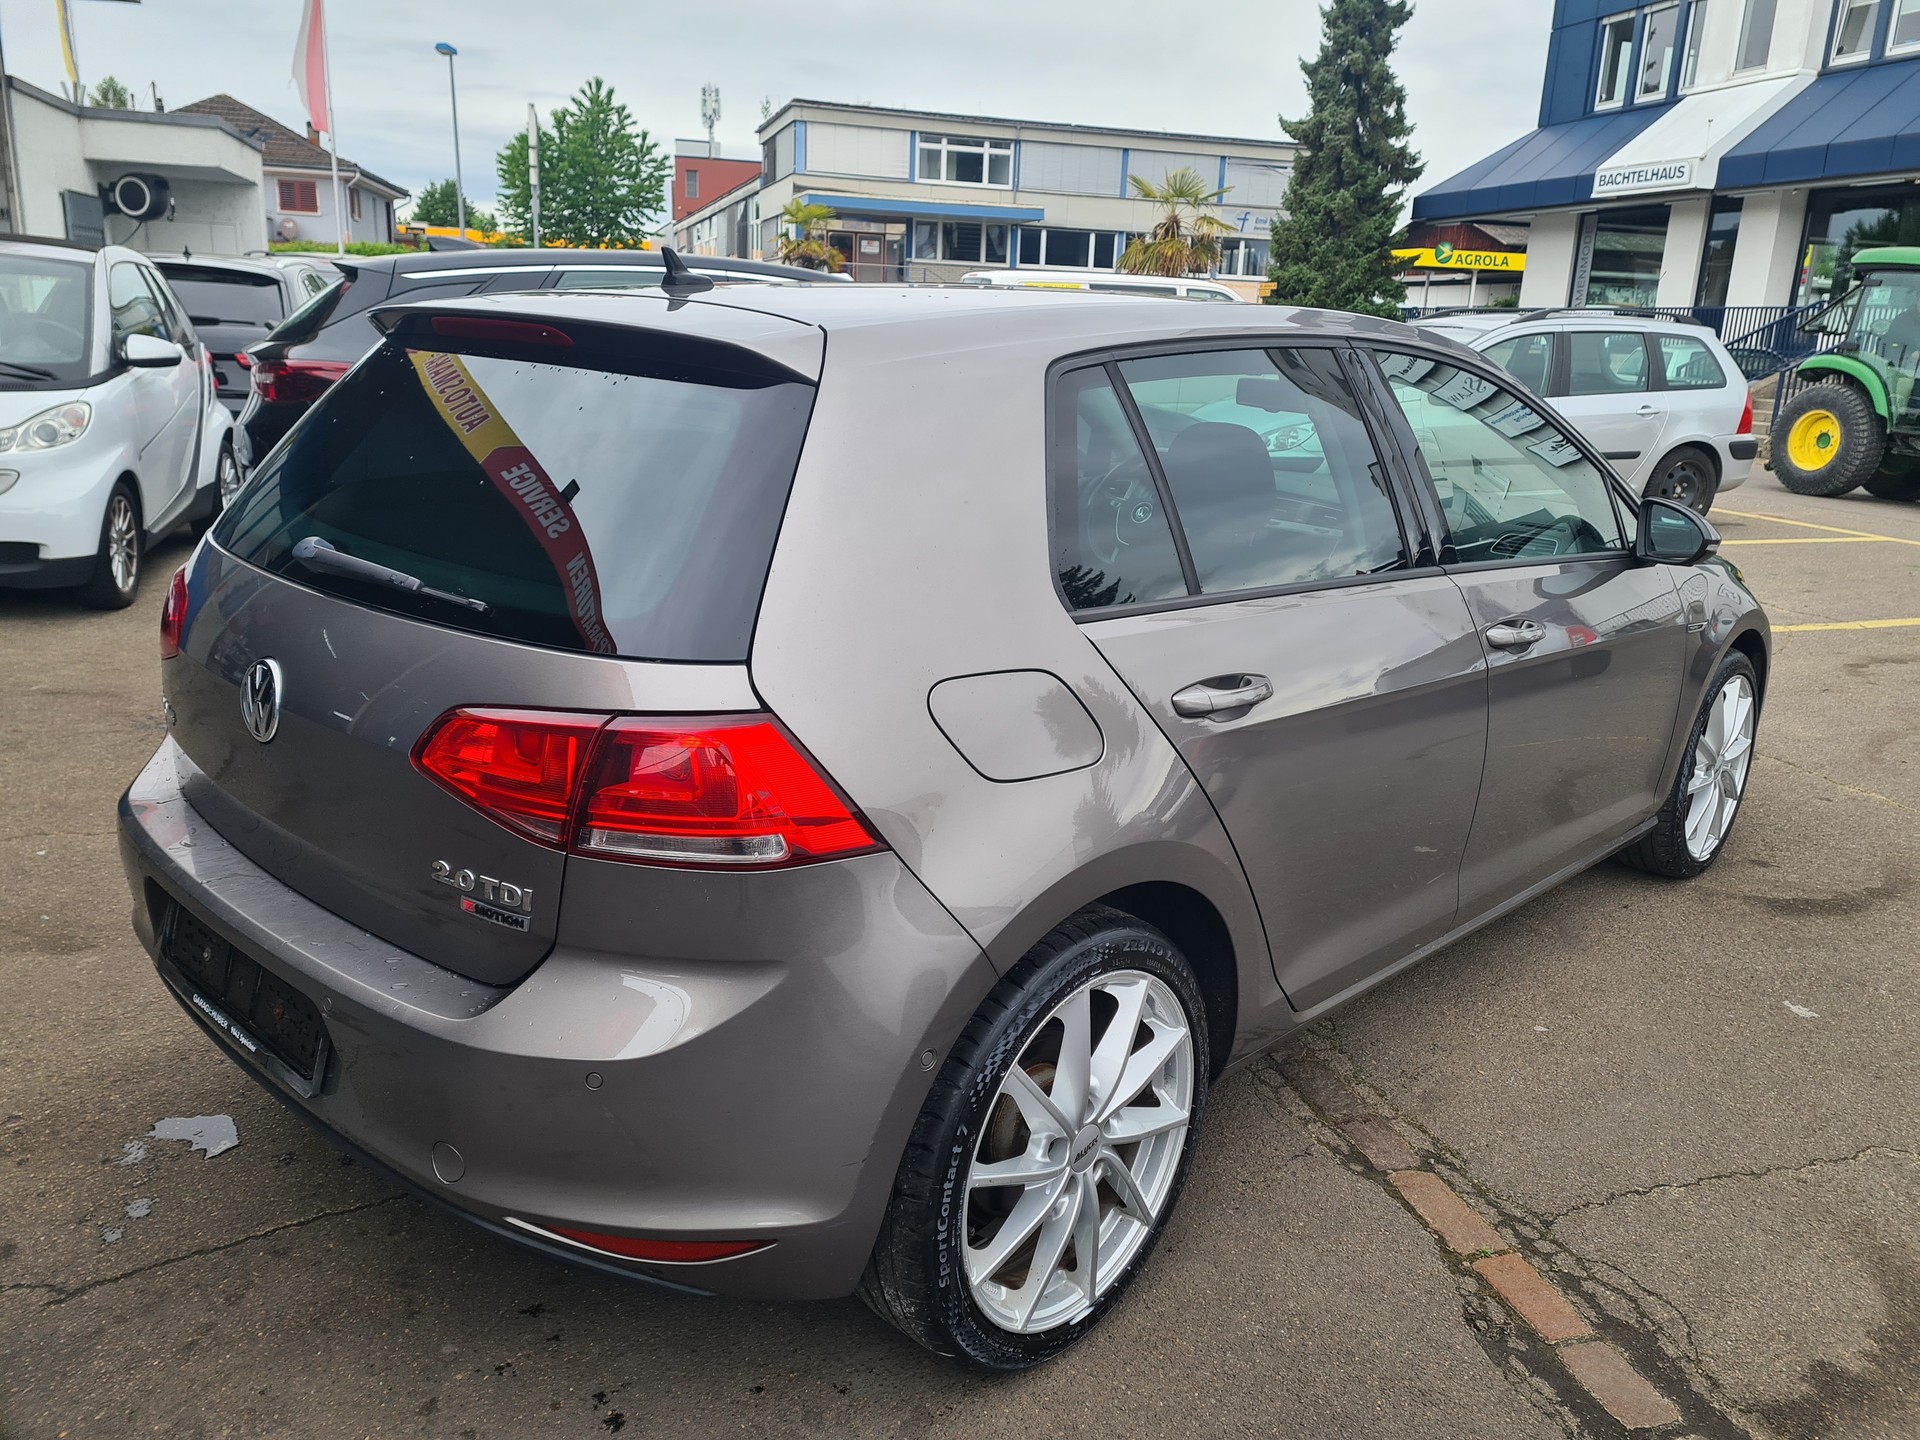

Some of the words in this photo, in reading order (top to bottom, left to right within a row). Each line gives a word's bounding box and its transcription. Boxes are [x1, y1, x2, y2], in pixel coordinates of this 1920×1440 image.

[1598, 165, 1686, 187] BACHTELHAUS
[1454, 253, 1509, 267] AGROLA
[1574, 225, 1594, 308] AMENMODE
[431, 860, 476, 892] 2.0
[479, 874, 534, 912] TDI
[937, 1144, 963, 1289] SportContact
[956, 1123, 968, 1137] 7
